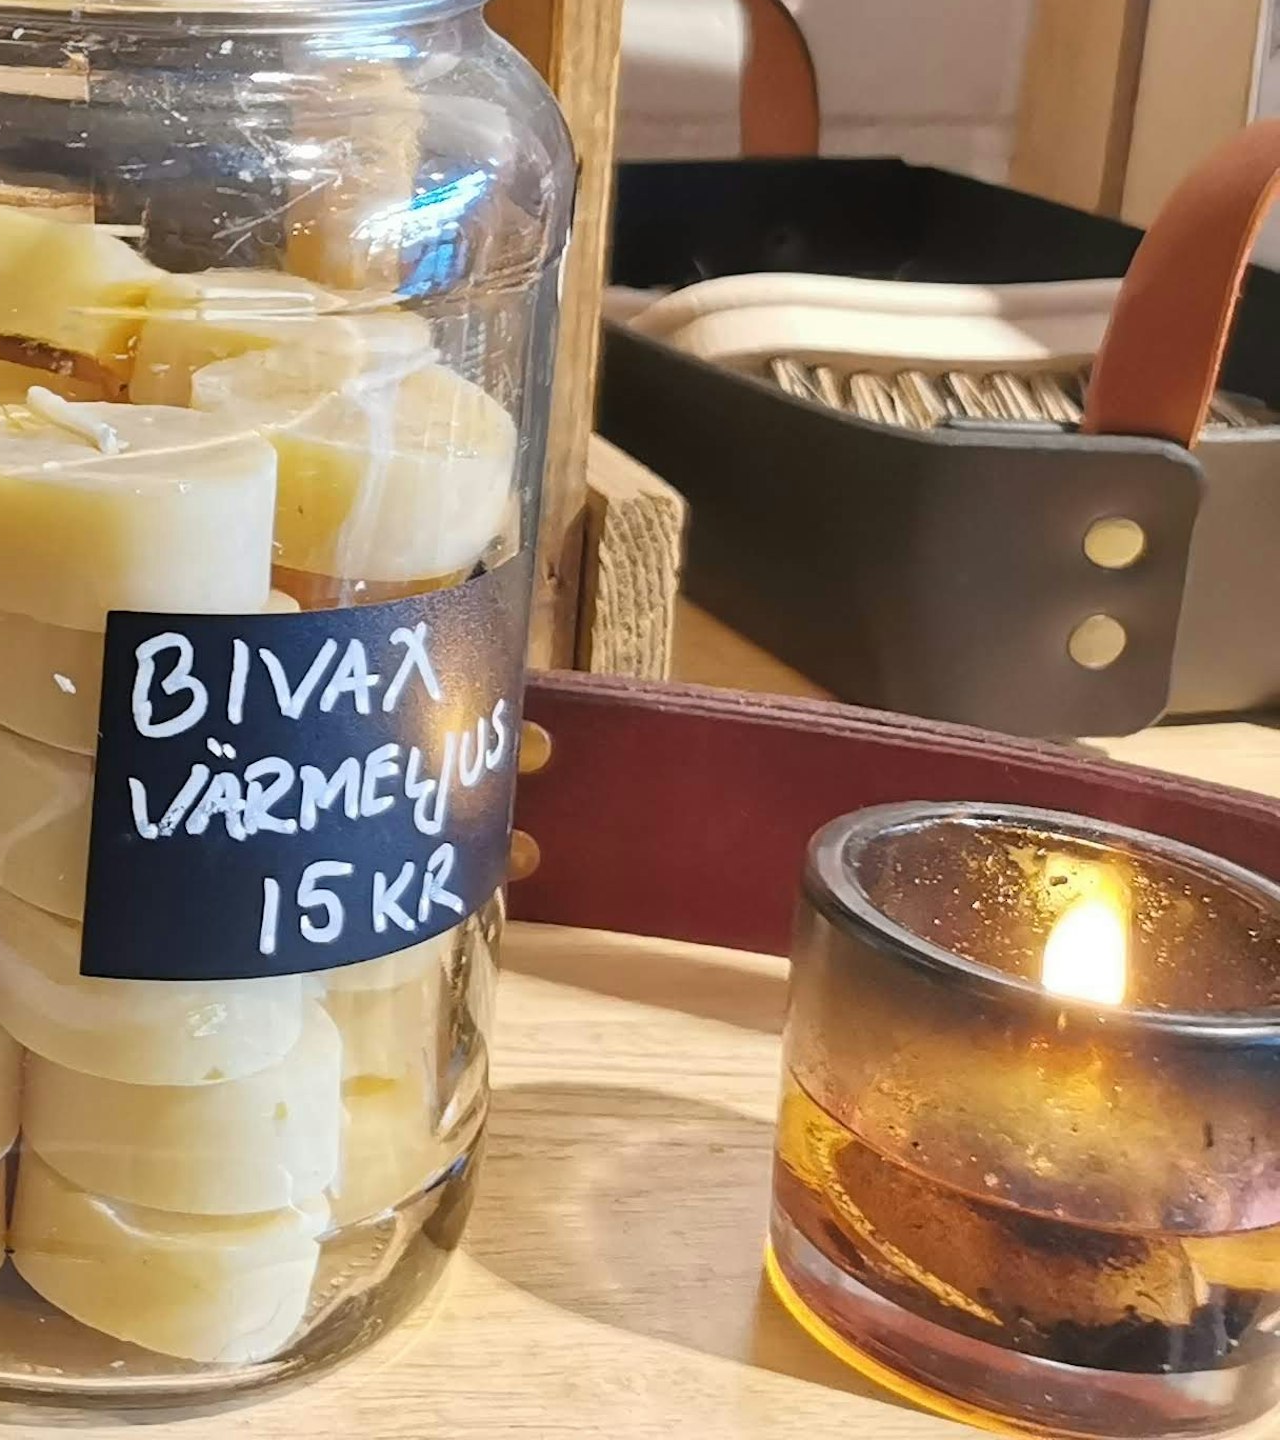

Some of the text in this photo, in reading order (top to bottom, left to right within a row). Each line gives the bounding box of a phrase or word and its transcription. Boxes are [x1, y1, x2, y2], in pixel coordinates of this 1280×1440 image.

[131, 620, 441, 739] BIVAX
[128, 698, 507, 841] VÄRMELJUS
[258, 842, 464, 955] 15 KR
